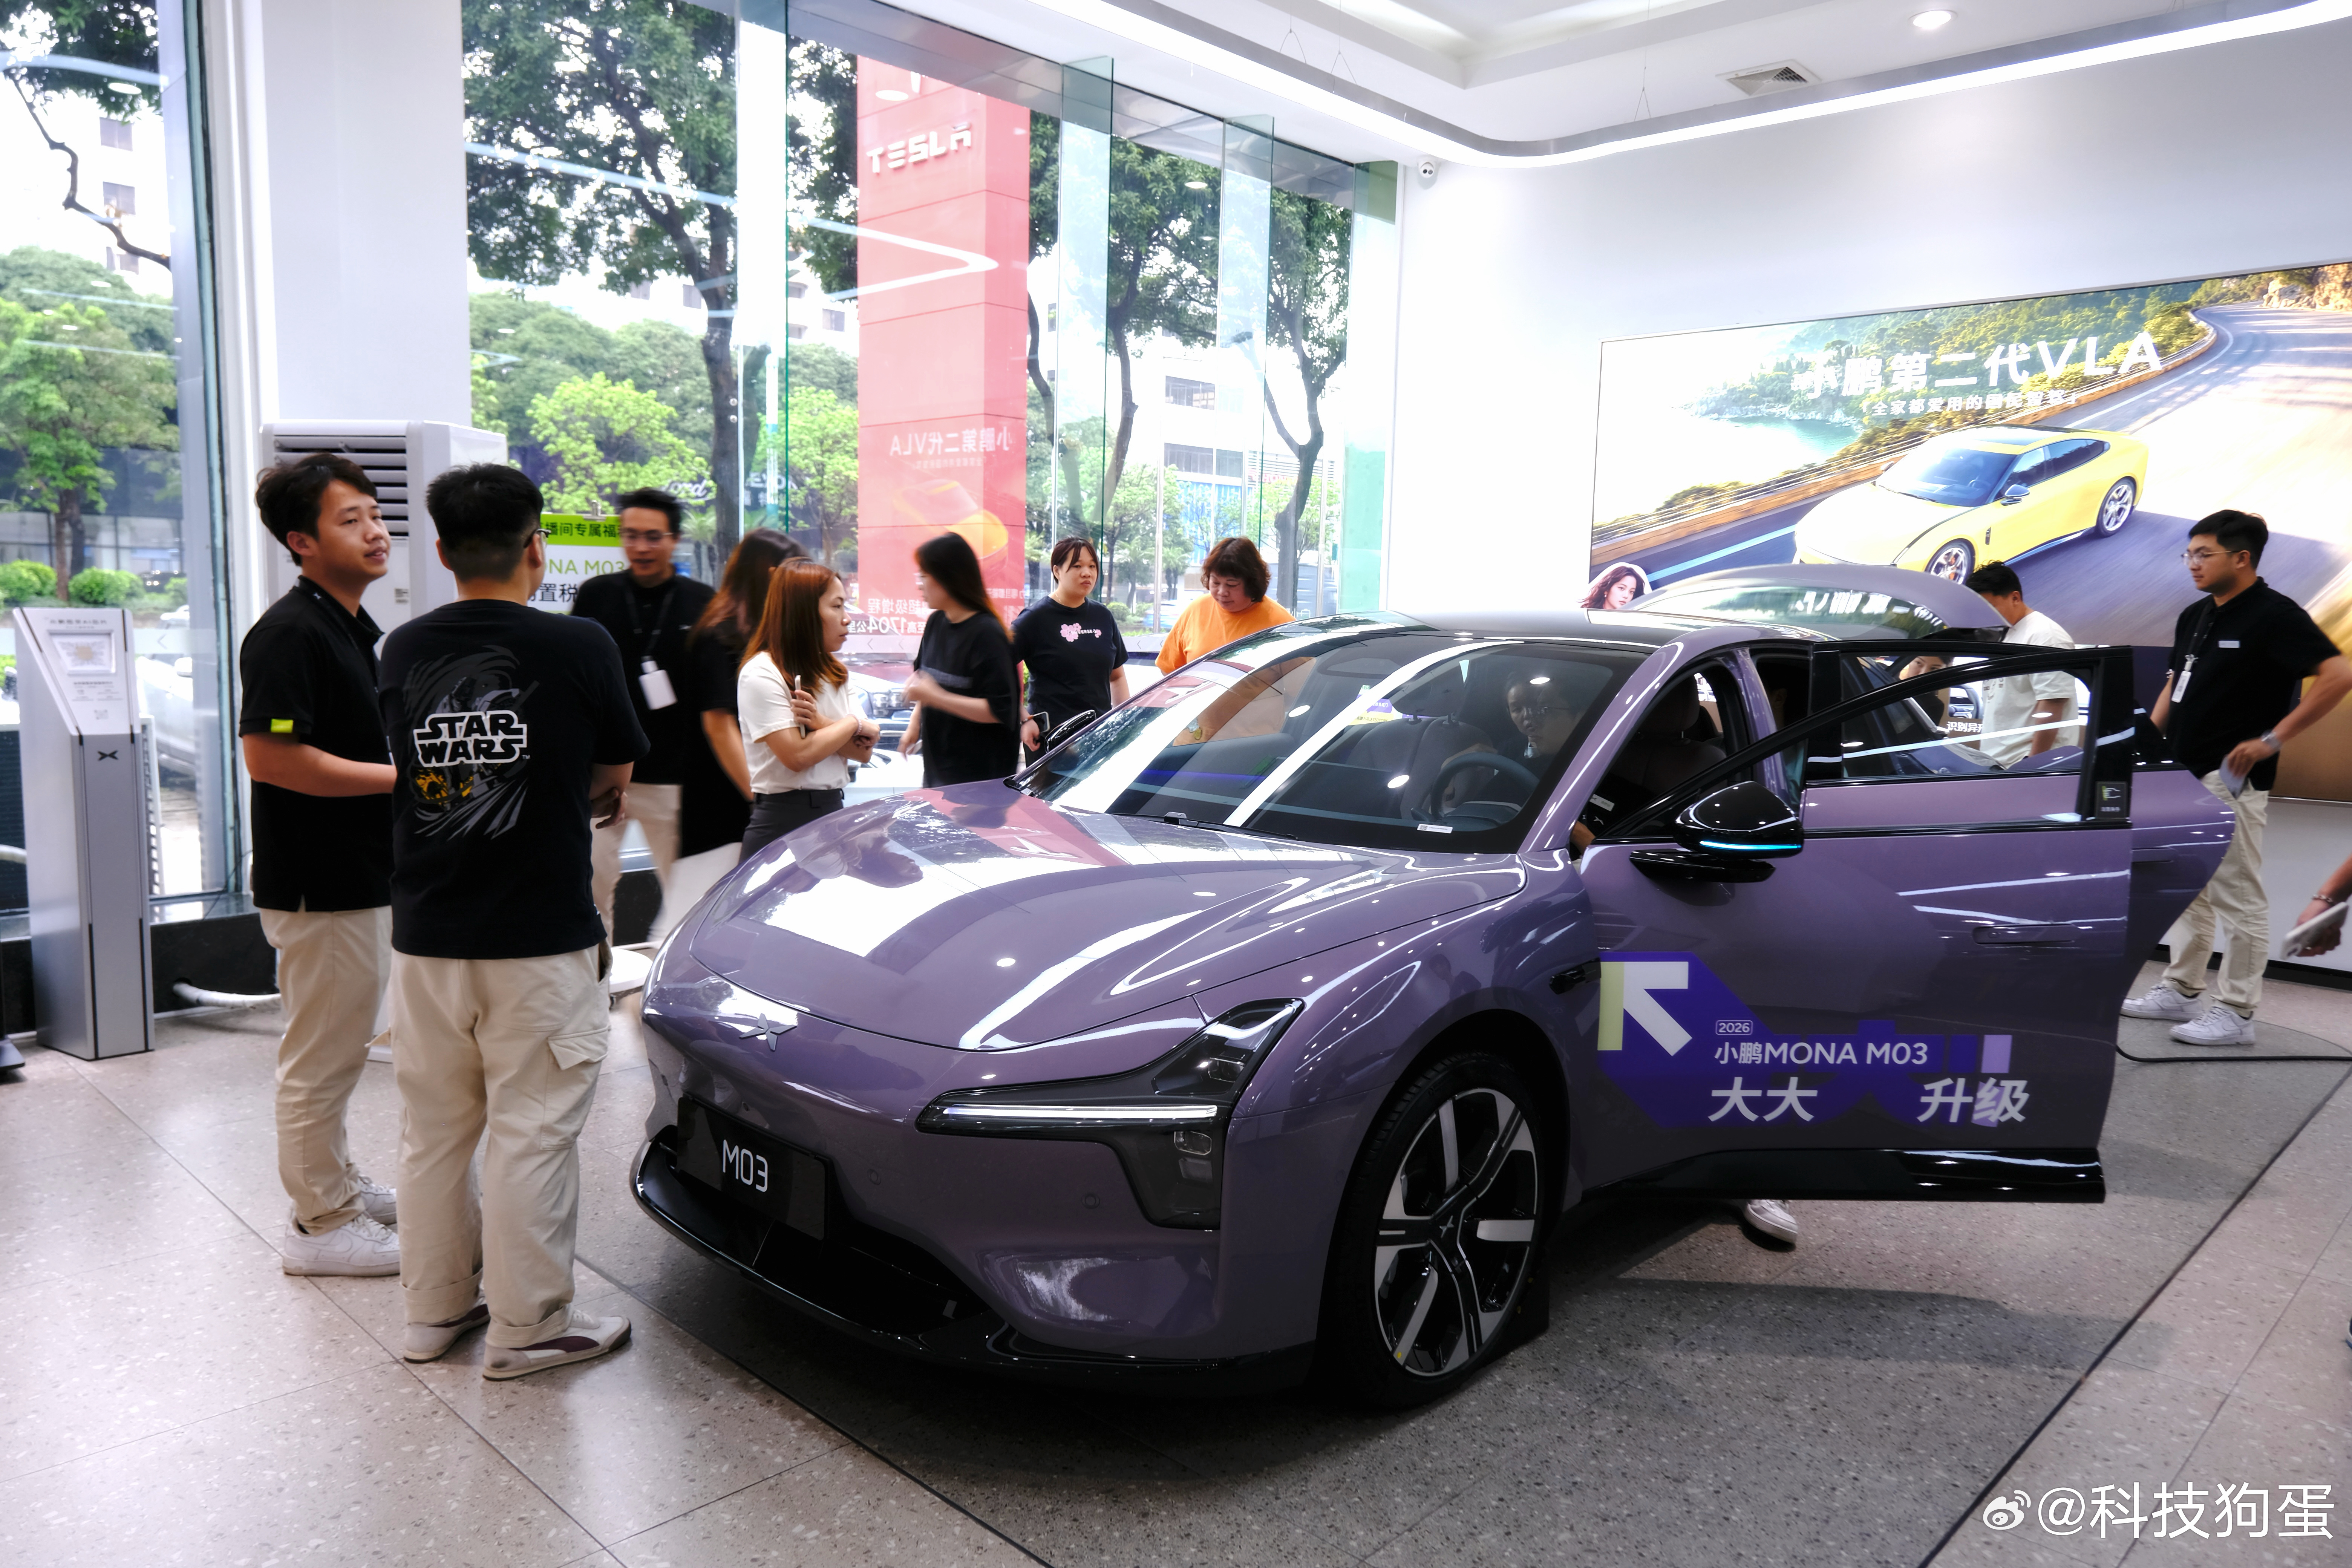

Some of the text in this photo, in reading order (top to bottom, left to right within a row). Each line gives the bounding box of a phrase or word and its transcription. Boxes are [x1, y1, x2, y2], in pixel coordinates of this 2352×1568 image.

[866, 122, 971, 173] TESLA
[1796, 332, 2162, 400] 小鹏第二代VLA
[541, 522, 619, 537] 播间专属福
[545, 559, 578, 575] NA
[413, 710, 527, 740] STAR
[417, 737, 527, 767] WARS
[1718, 1023, 1750, 1033] 2026
[1715, 1042, 1928, 1064] 小鹏MONA M03
[1708, 1076, 2030, 1122] 大大 升级
[723, 1139, 768, 1192] M03
